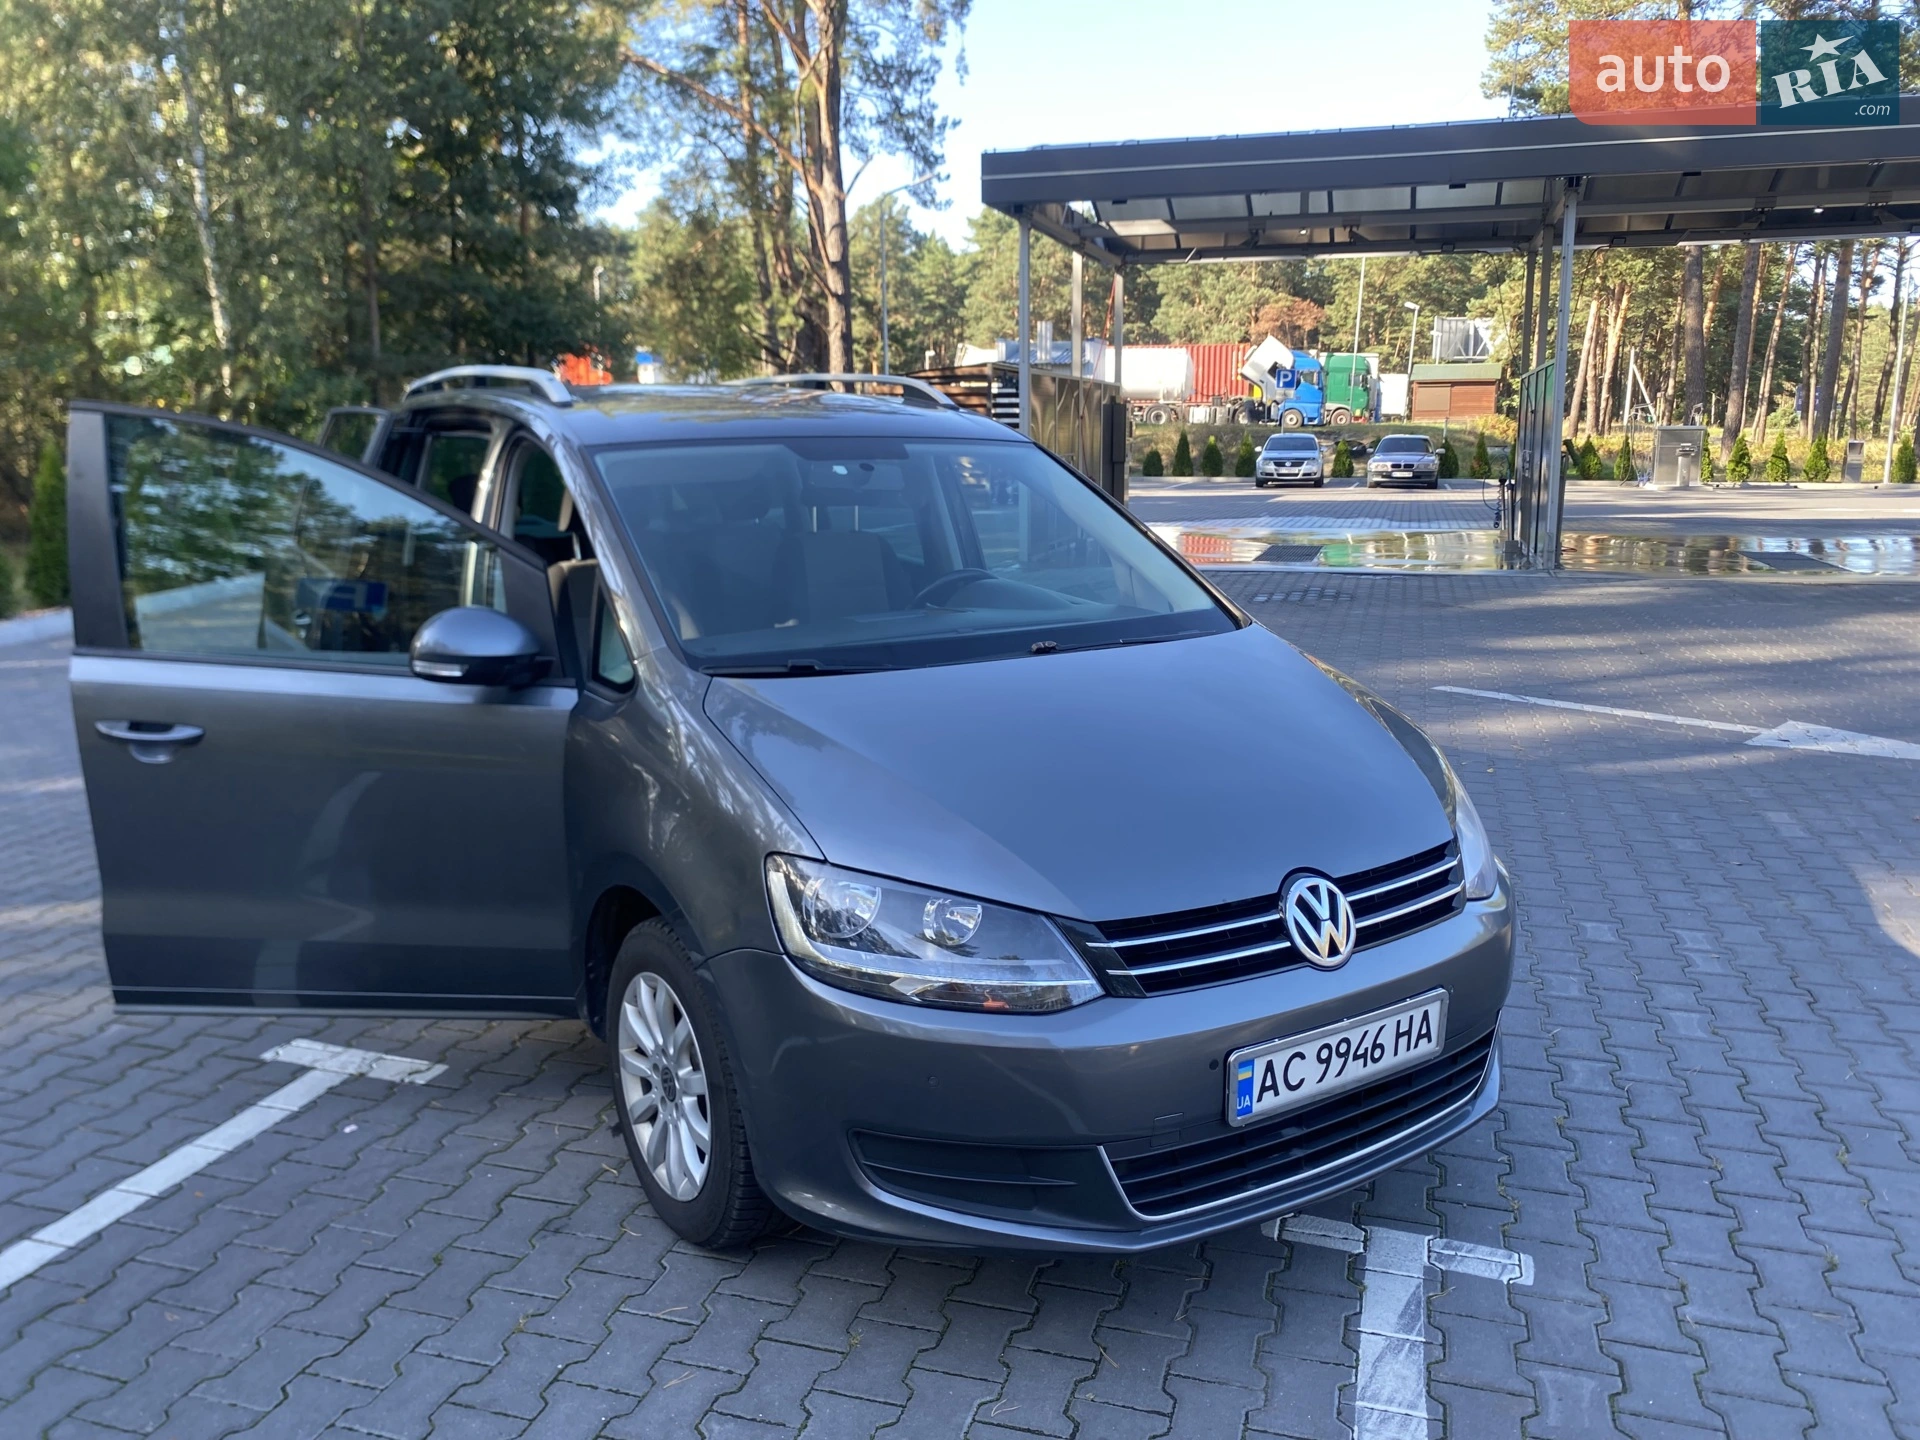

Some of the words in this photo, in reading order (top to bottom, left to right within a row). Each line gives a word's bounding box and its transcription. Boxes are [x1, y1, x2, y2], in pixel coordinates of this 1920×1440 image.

[1279, 370, 1292, 388] P
[1256, 1051, 1306, 1103] AC
[1315, 1023, 1387, 1084] 9946
[1393, 1008, 1433, 1057] HA
[1236, 1094, 1252, 1110] UA
